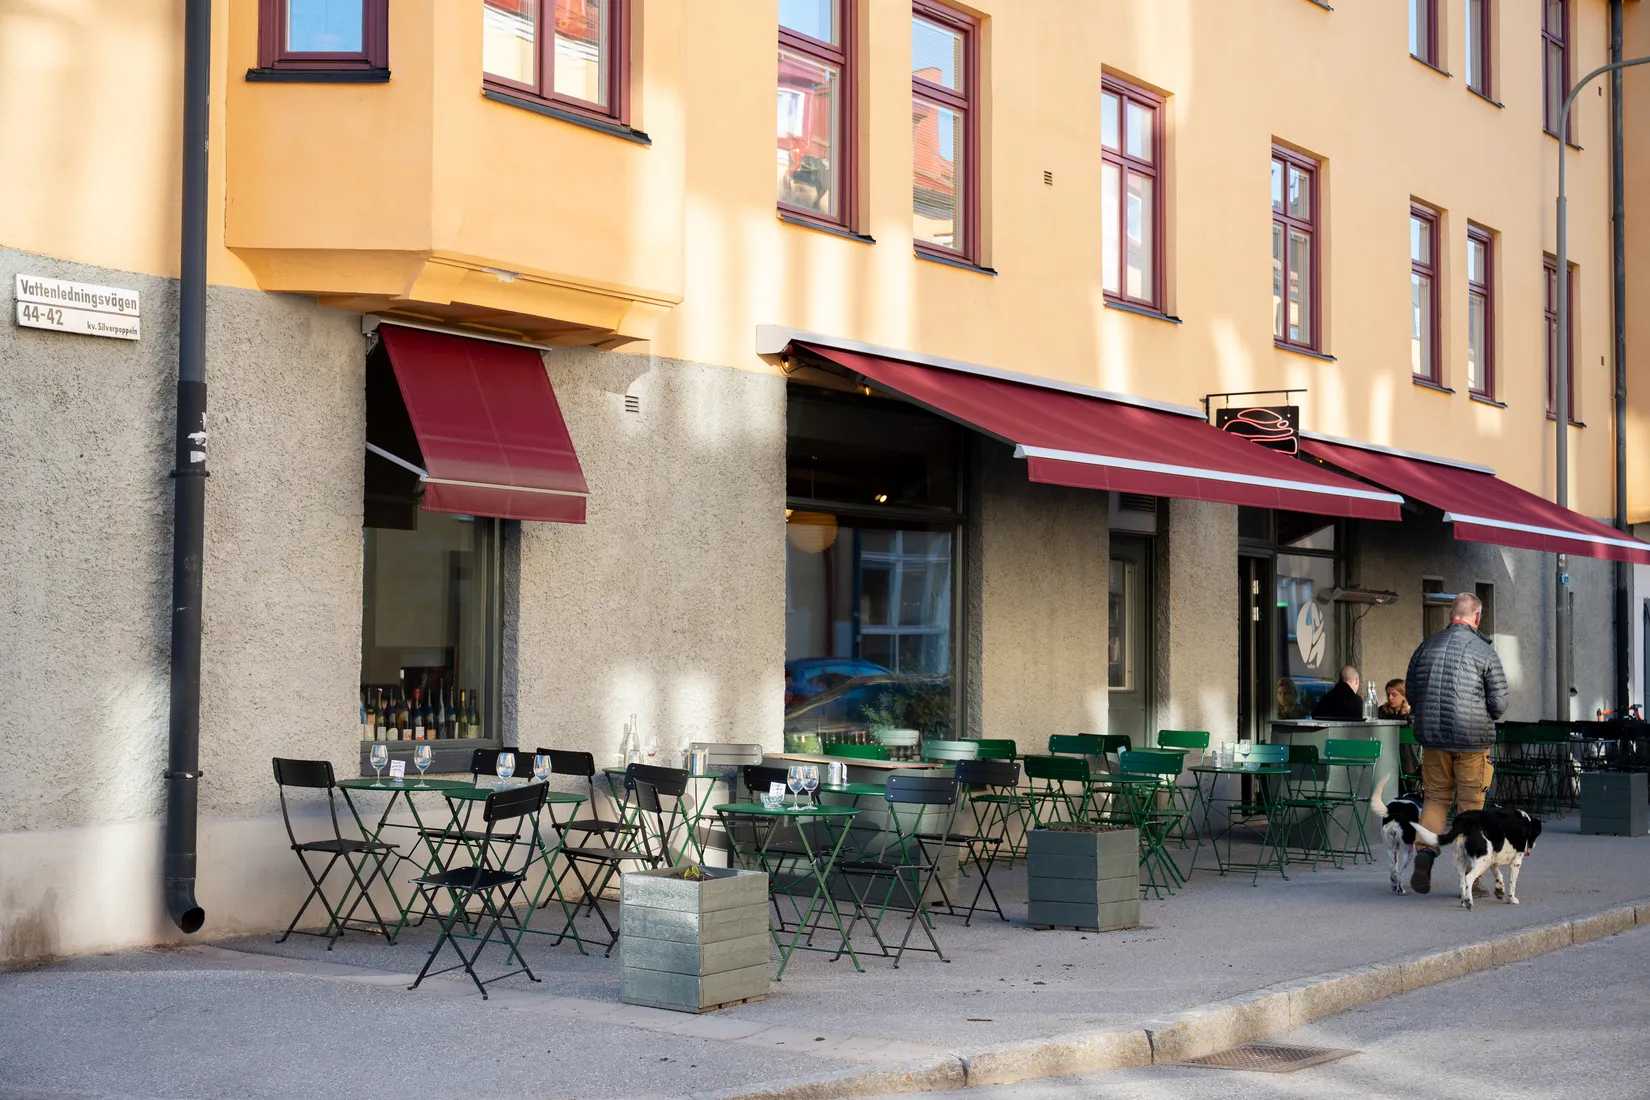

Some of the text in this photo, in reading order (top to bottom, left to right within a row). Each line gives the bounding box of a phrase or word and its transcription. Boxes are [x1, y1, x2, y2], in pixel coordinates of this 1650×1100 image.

[20, 279, 137, 312] Vattenledningsvägen
[23, 304, 64, 326] 44-42
[87, 320, 138, 336] kv. Silverpoppeln
